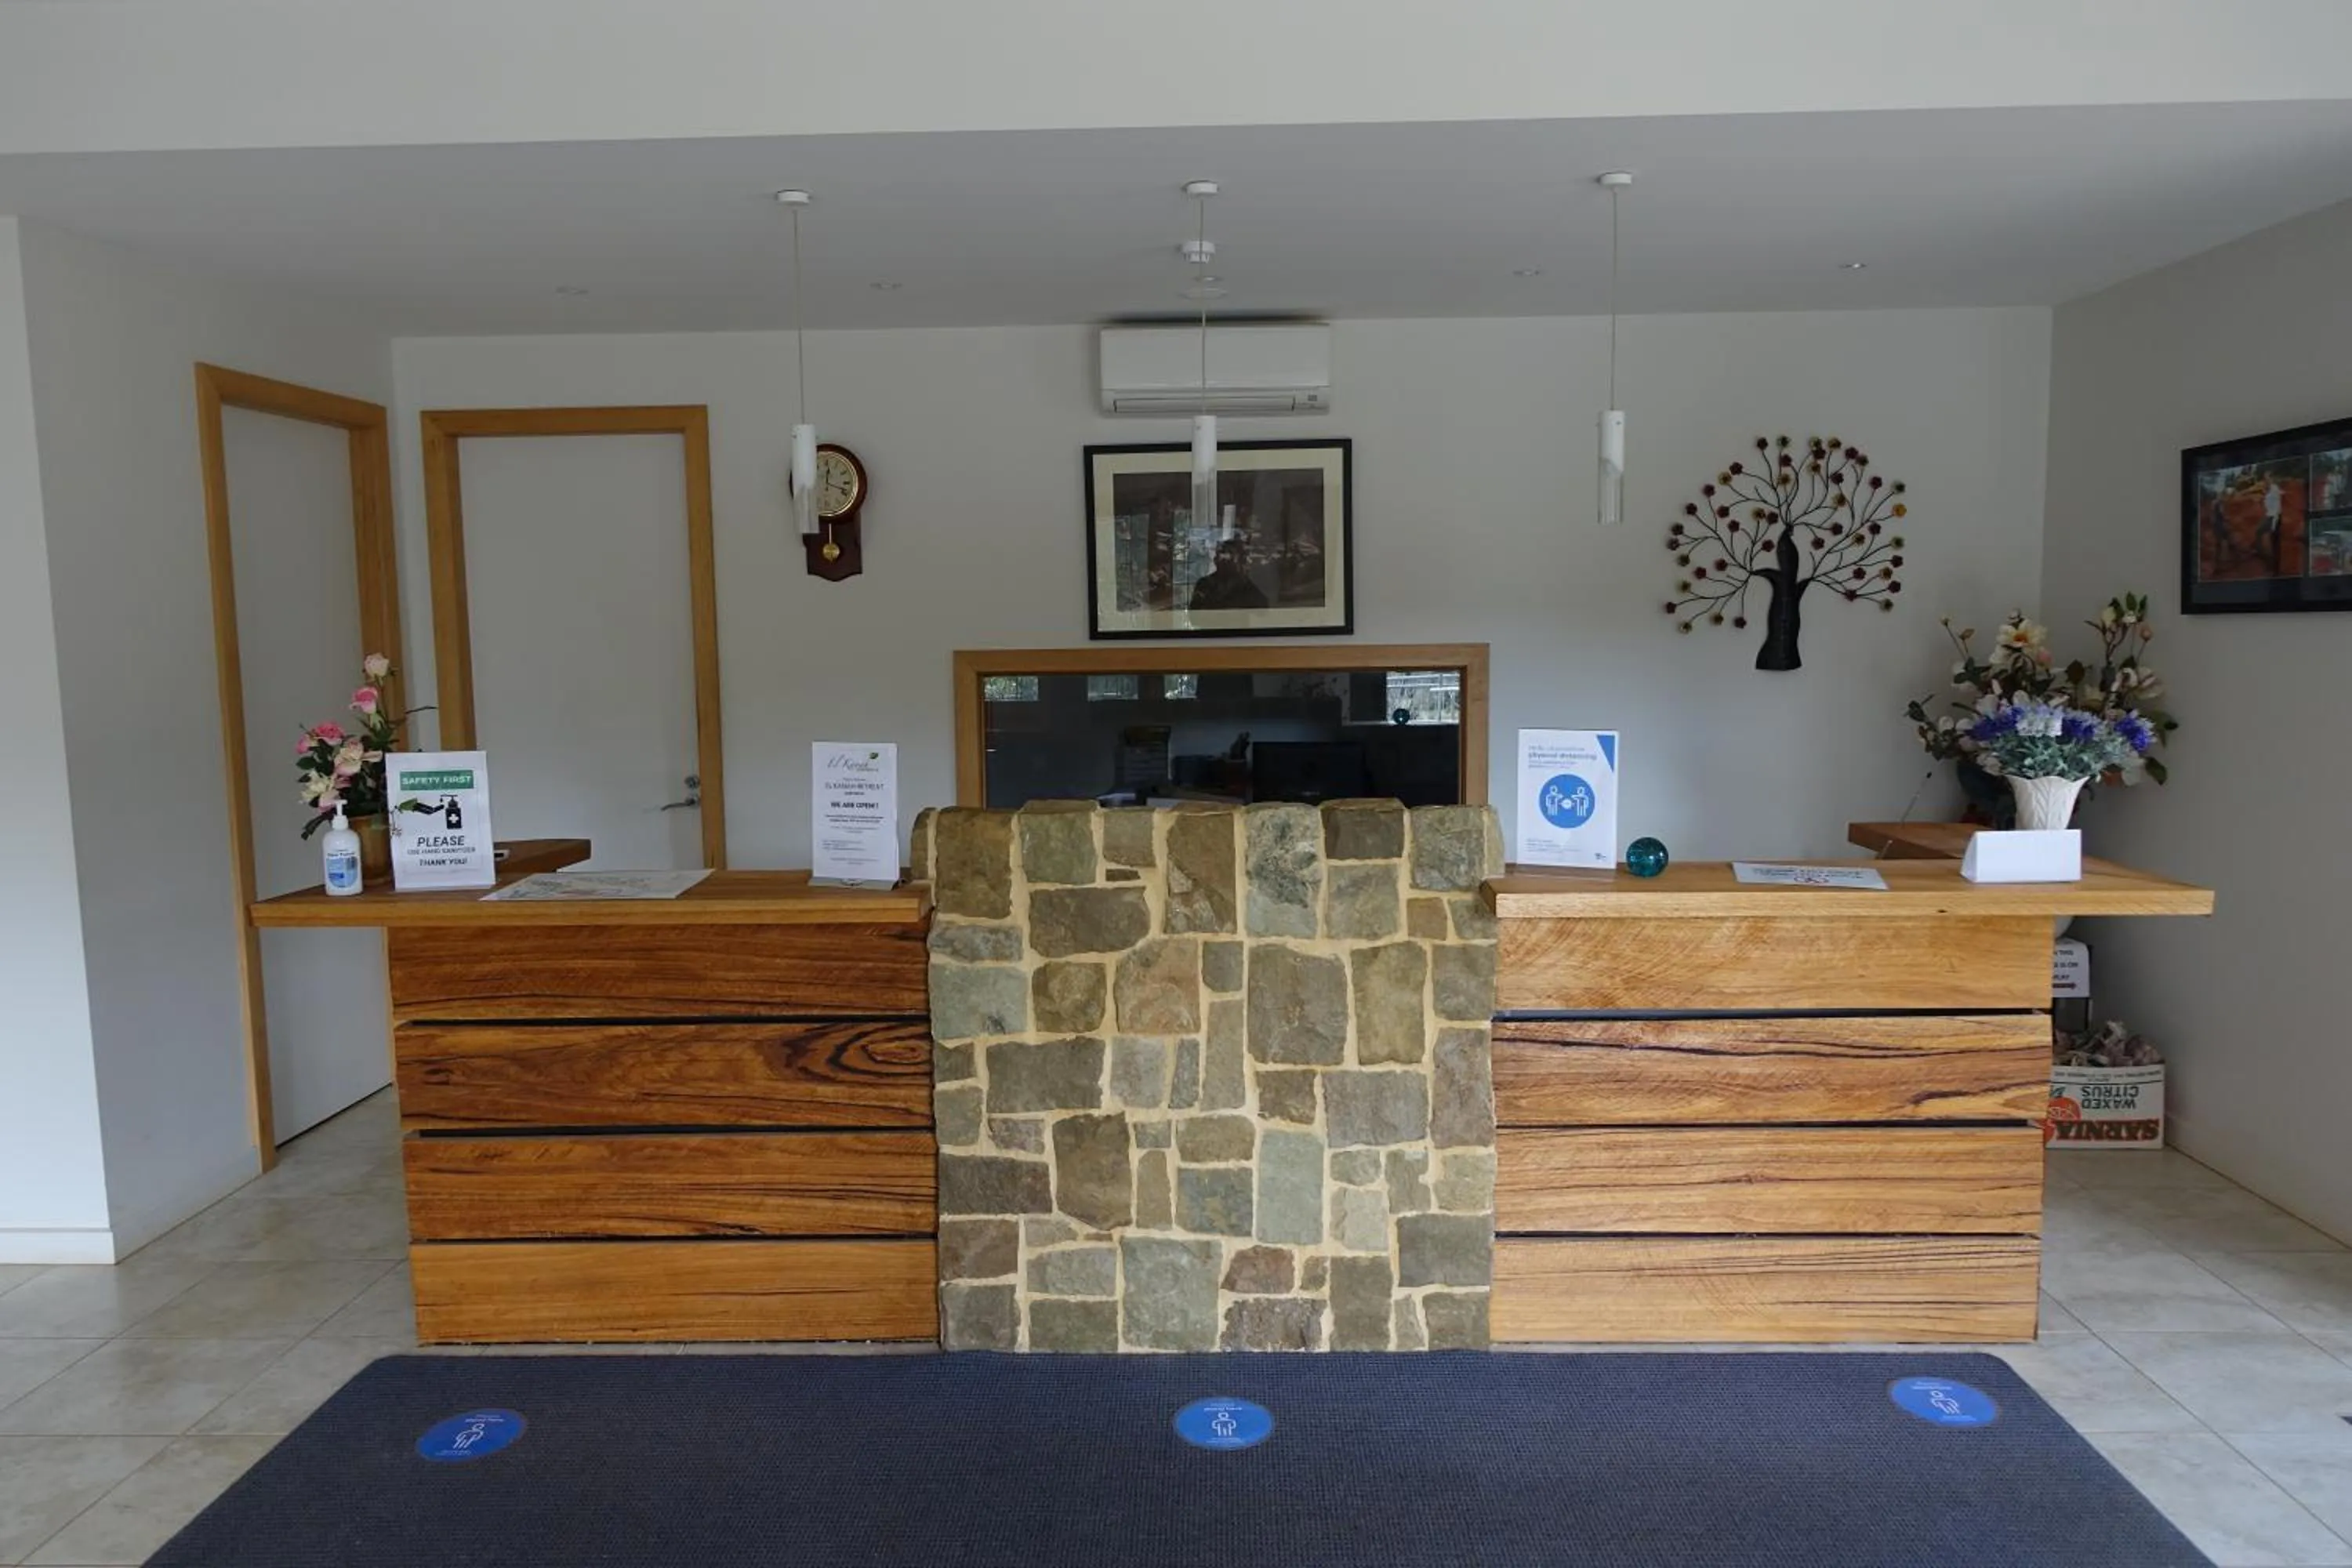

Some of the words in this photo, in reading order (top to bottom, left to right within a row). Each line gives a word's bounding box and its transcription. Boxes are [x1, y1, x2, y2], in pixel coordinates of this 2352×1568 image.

[401, 776, 440, 785] SAFETY
[443, 775, 471, 784] FIRST
[416, 835, 465, 848] PLEASE
[2082, 1086, 2139, 1098] CITRUS
[2082, 1098, 2136, 1109] WAXED
[2056, 1119, 2159, 1141] SARNIA
